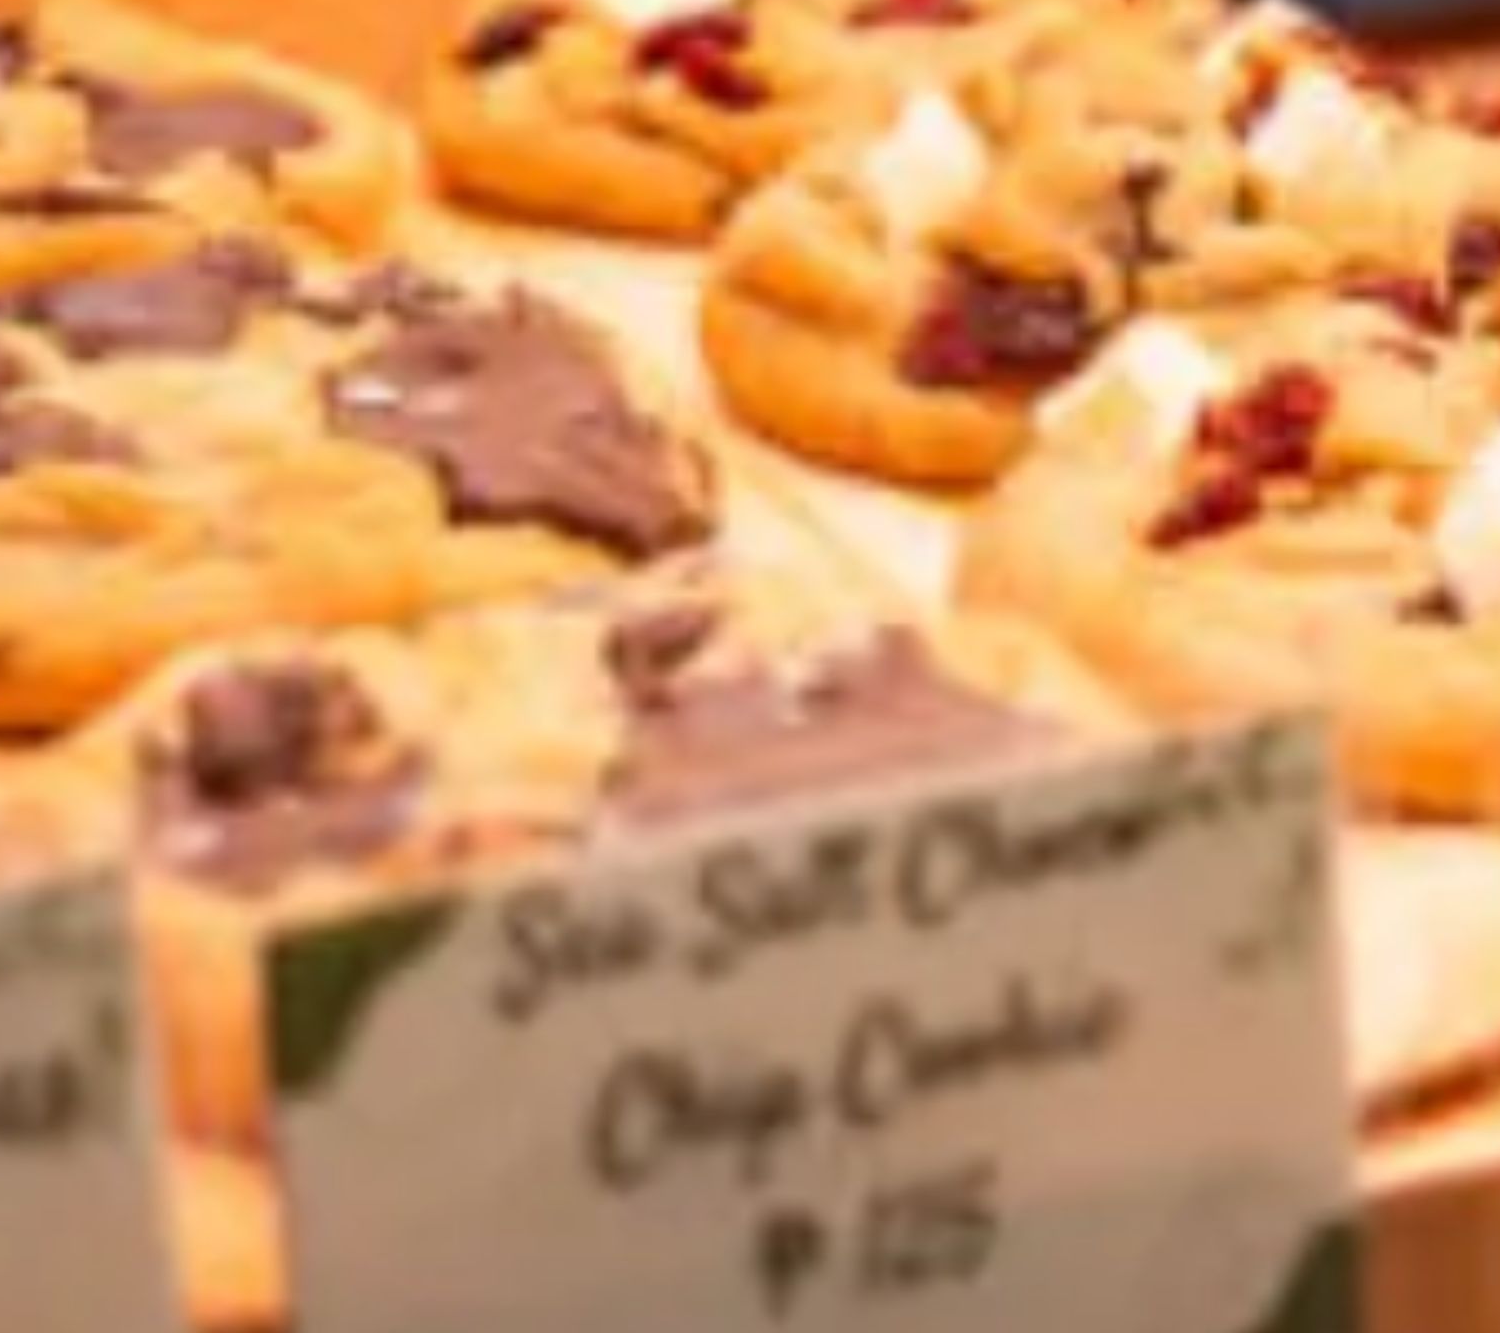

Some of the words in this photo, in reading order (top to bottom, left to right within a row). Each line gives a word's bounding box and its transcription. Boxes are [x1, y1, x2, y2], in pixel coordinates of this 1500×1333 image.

[492, 883, 658, 1025] Sea
[682, 825, 878, 981] Salt
[585, 1043, 808, 1198] Chip
[833, 973, 1128, 1131] Cookie
[852, 1155, 1000, 1298] 125
